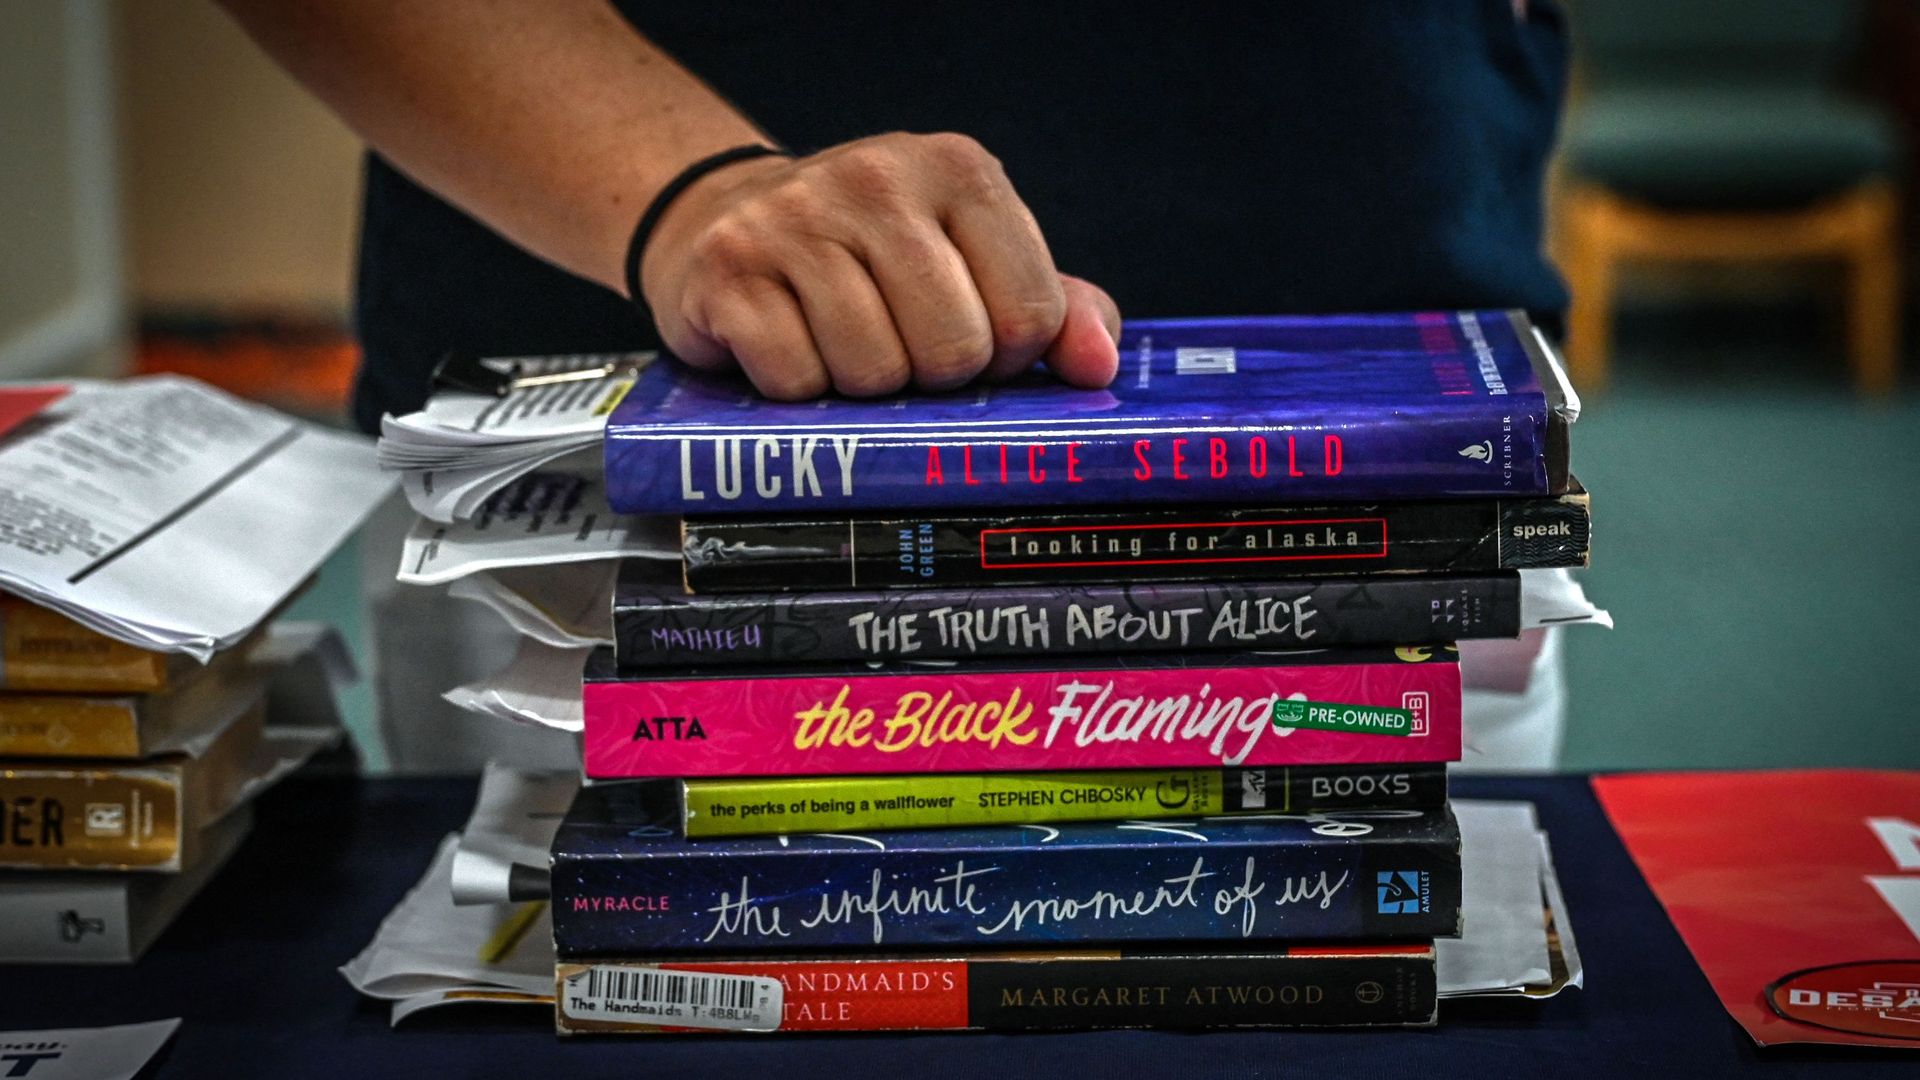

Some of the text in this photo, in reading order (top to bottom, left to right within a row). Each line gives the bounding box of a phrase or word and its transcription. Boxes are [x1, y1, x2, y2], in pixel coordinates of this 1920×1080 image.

[681, 434, 1344, 500] LUCKY ALICE SEBOLD
[1503, 415, 1512, 486] SCRIBNER
[1010, 528, 1358, 556] looking for alaska
[1513, 521, 1571, 539] speak
[900, 528, 914, 573] JOHN
[920, 523, 934, 577] GREEN
[651, 596, 1317, 653] MATHIEU THE TRUTH ABOUT ALICE
[632, 717, 707, 741] ATTA
[793, 684, 874, 750] the
[875, 687, 1038, 753] Black
[1308, 708, 1405, 728] PRE-OWNED
[710, 785, 1146, 818] the perks of being a wallflower STEPHEN CHBOSKY
[1313, 774, 1410, 797] BOOKS
[0, 797, 63, 846] ER
[574, 855, 1349, 944] MYRACLE the infinite moment of us
[1421, 871, 1430, 913] AMULET
[753, 971, 955, 992] ANDMAID'S
[1000, 985, 1323, 1007] MARGARET ATWOOD
[570, 997, 596, 1011] The
[604, 1000, 682, 1017] Handmaids
[783, 1002, 850, 1021] TALE
